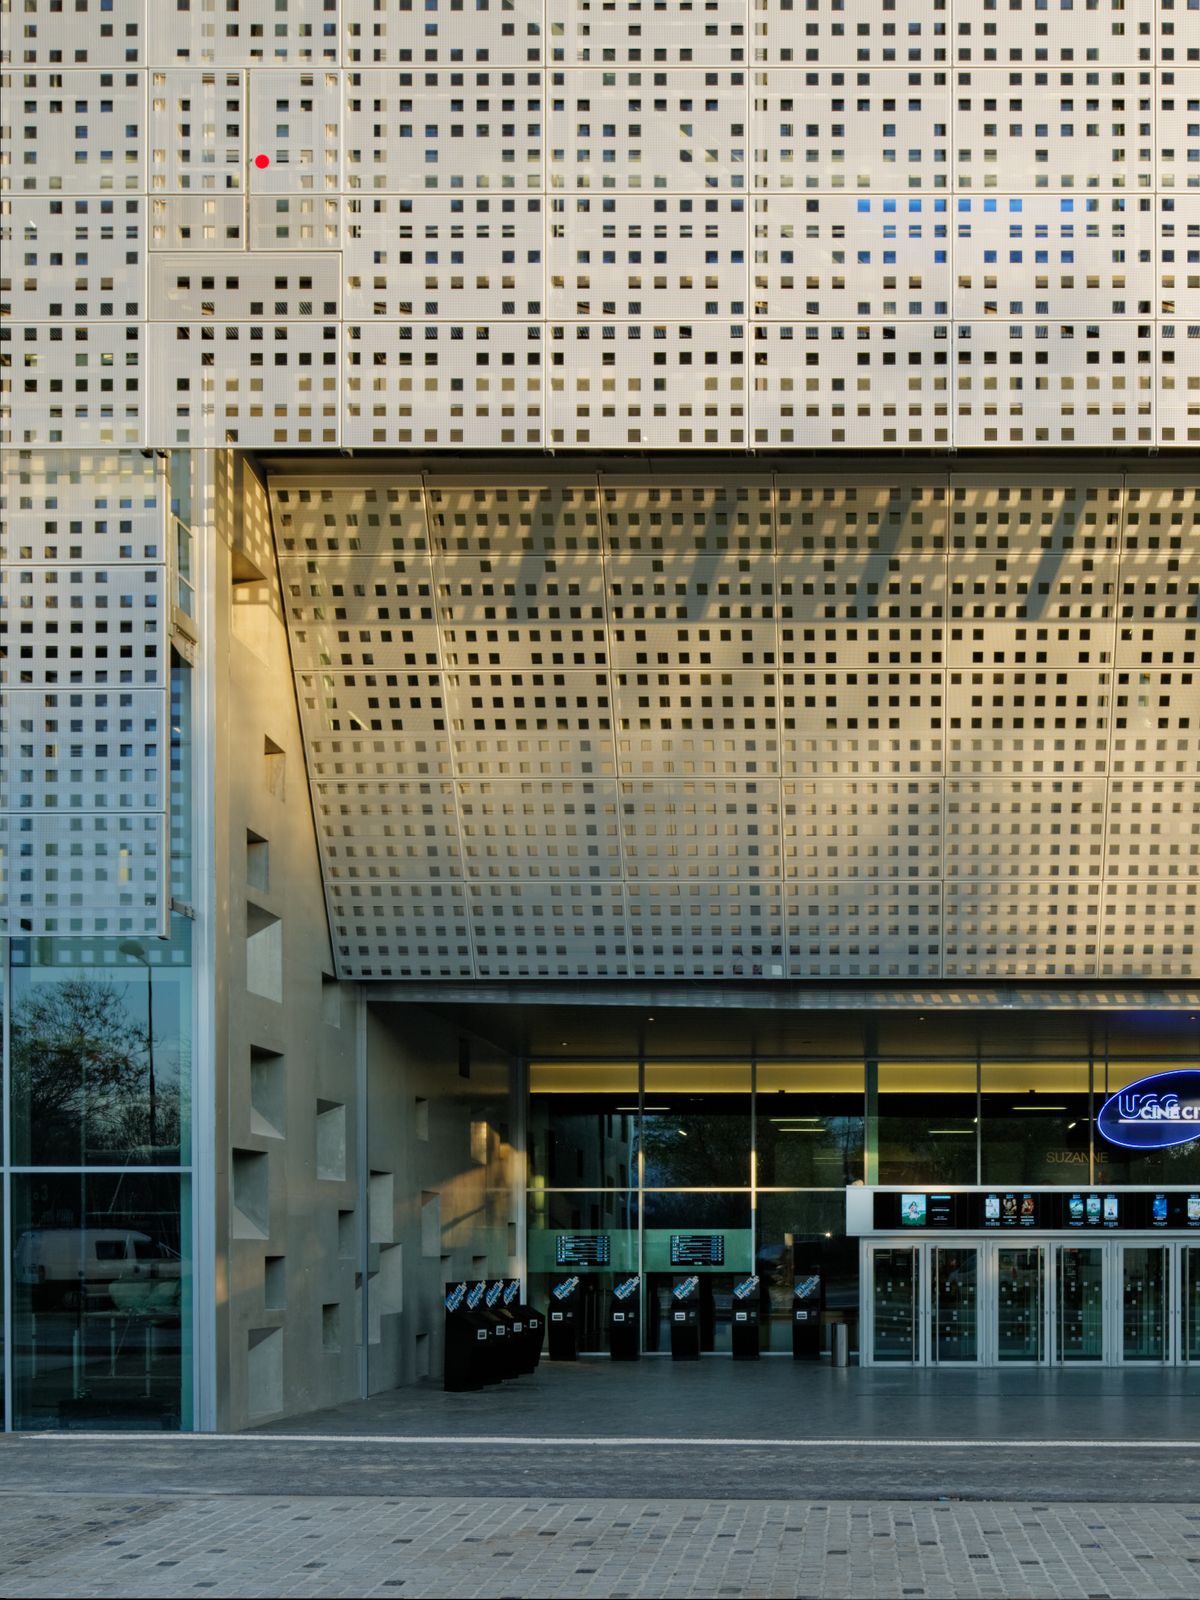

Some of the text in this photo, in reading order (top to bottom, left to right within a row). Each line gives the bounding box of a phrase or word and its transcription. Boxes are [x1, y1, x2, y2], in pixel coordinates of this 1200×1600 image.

[1118, 1093, 1178, 1119] UGC
[1140, 1103, 1180, 1120] CINÉ
[1046, 1151, 1110, 1163] SUZANNE
